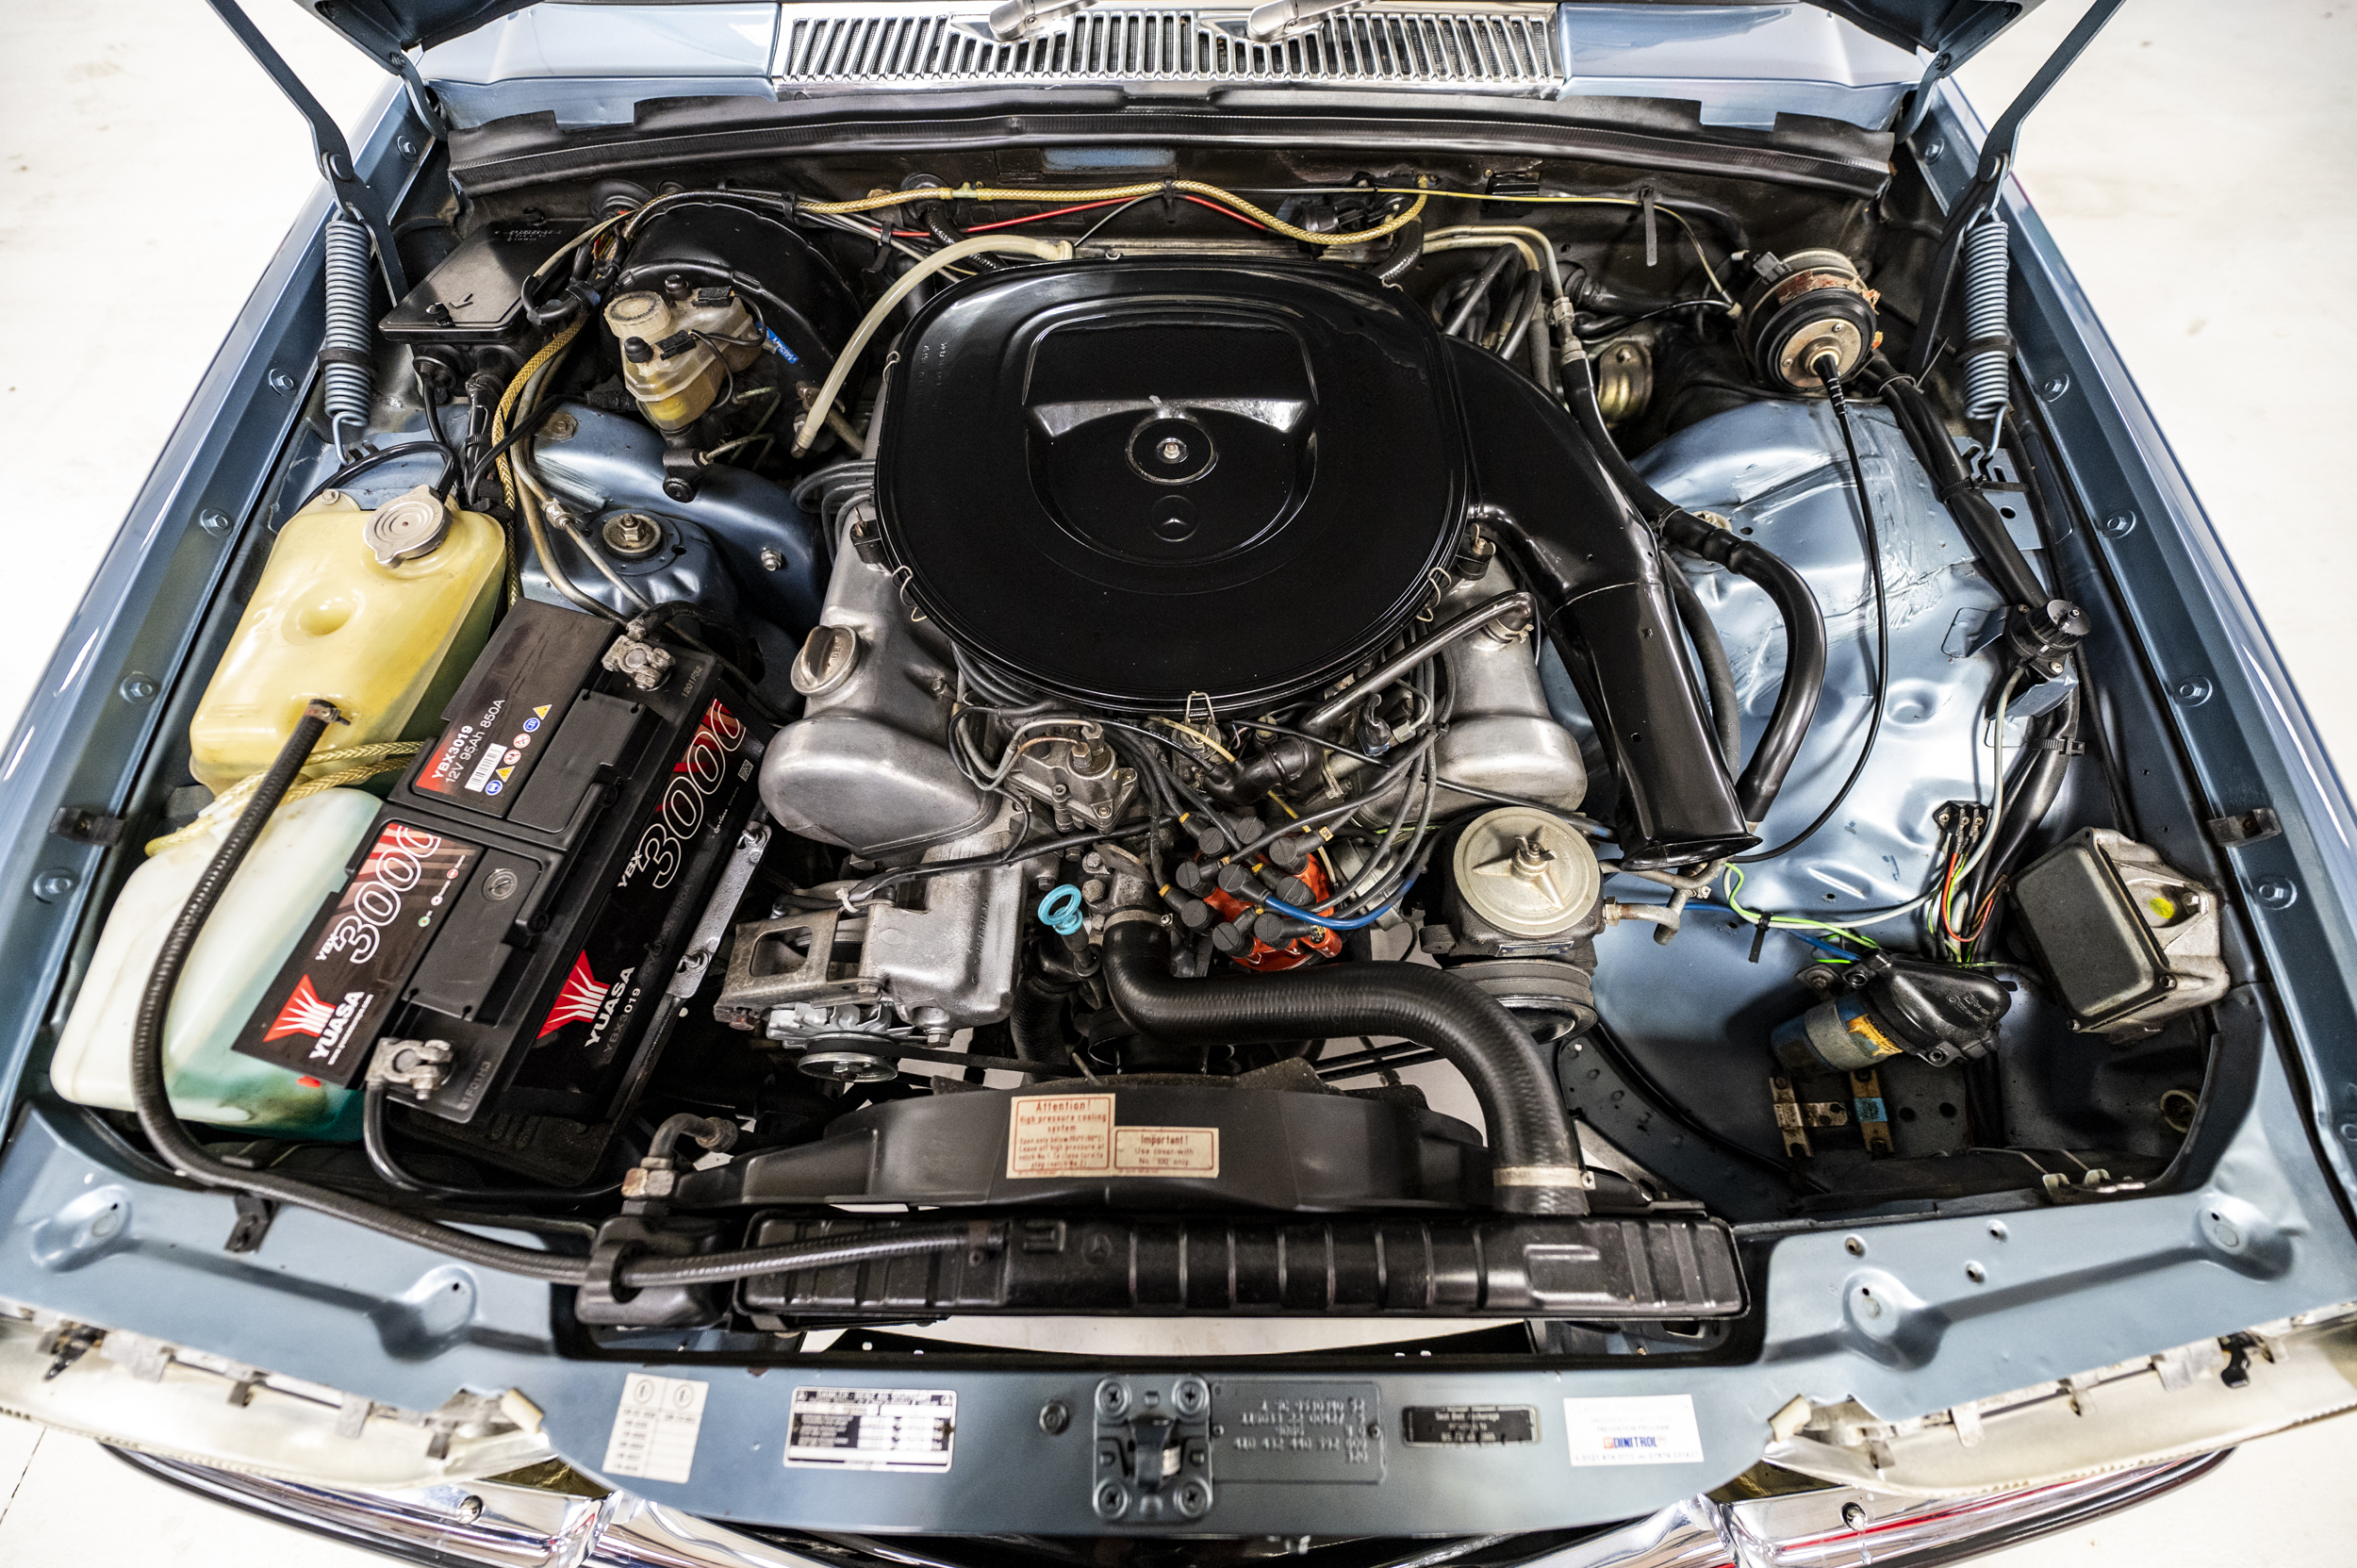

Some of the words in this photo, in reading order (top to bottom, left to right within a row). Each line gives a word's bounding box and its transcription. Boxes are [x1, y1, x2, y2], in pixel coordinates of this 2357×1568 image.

[681, 665, 703, 698] 1201F32
[431, 725, 474, 782] YBX3019
[444, 760, 465, 784] 12V
[459, 730, 485, 762] 95Ah
[478, 699, 505, 730] 850A
[308, 991, 365, 1060] YUASA
[584, 966, 636, 1048] YUASA
[602, 987, 642, 1053] YBX3019
[1019, 1114, 1035, 1125] High
[1038, 1114, 1075, 1124] pressure
[1078, 1113, 1107, 1123] cooling
[1047, 1124, 1077, 1134] system
[1613, 1436, 1657, 1448] DINITROL
